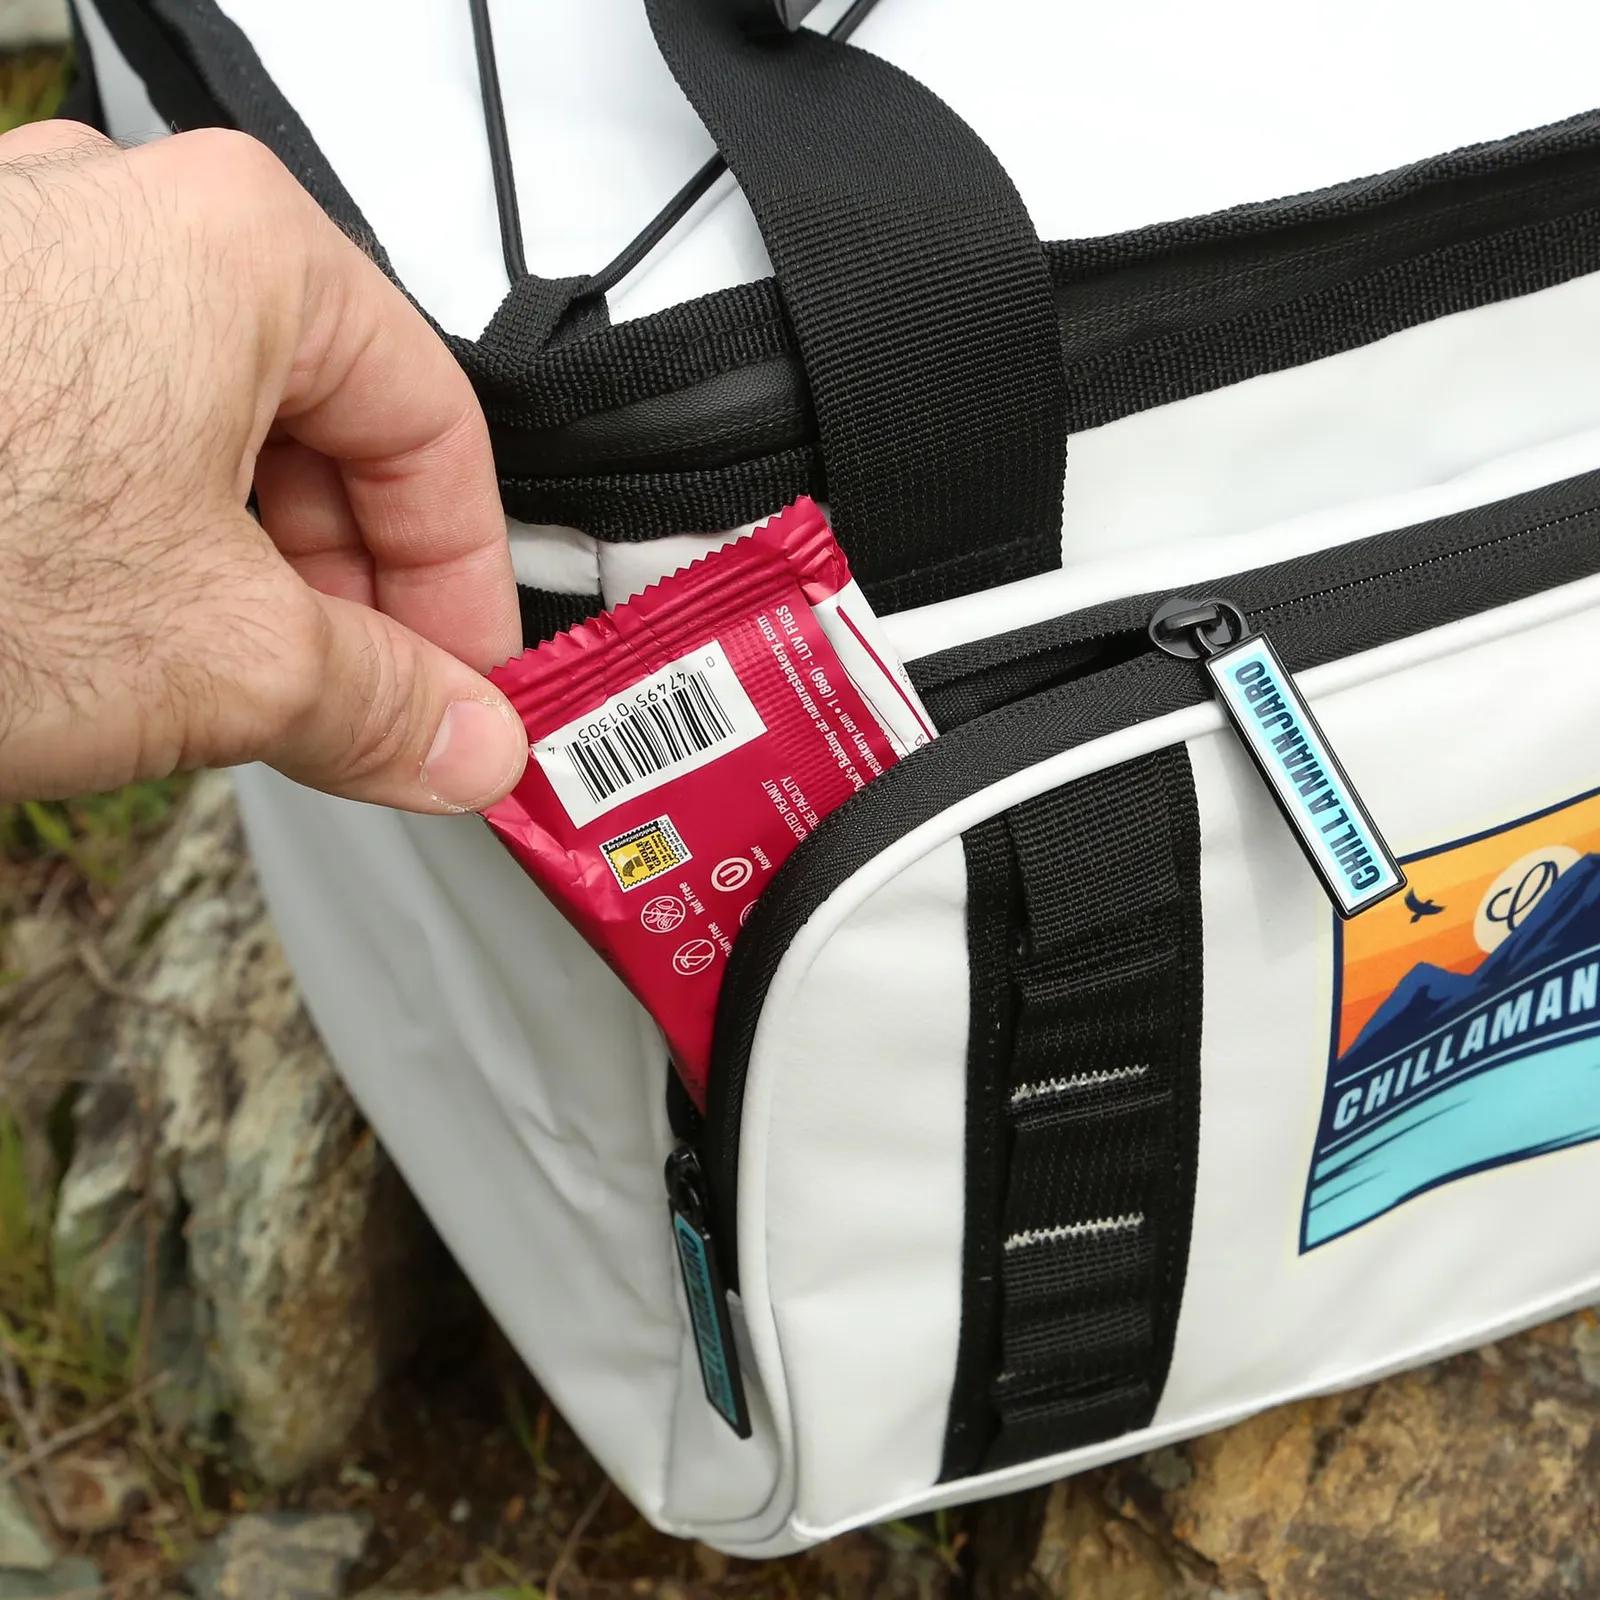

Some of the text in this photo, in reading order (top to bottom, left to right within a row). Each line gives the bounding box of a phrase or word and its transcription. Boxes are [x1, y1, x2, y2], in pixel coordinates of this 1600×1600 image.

[774, 603, 800, 635] FIGS
[790, 633, 813, 660] LUV
[755, 614, 823, 721] naturesbakery.com
[807, 665, 837, 699] (866)
[546, 655, 715, 755] 0 47495 01305 4
[814, 718, 830, 734] at:
[820, 730, 853, 769] Baking
[1235, 659, 1382, 893] CHILLAMANJARO
[761, 777, 810, 842] ICATED PEANUT
[779, 774, 811, 813] FACILITY
[635, 841, 656, 871] WHOLE
[642, 839, 661, 866] GRAIN
[748, 844, 772, 870] Kosher
[676, 880, 706, 915] Nut Free
[705, 920, 723, 939] Free
[1333, 963, 1600, 1132] CHILLAMAN
